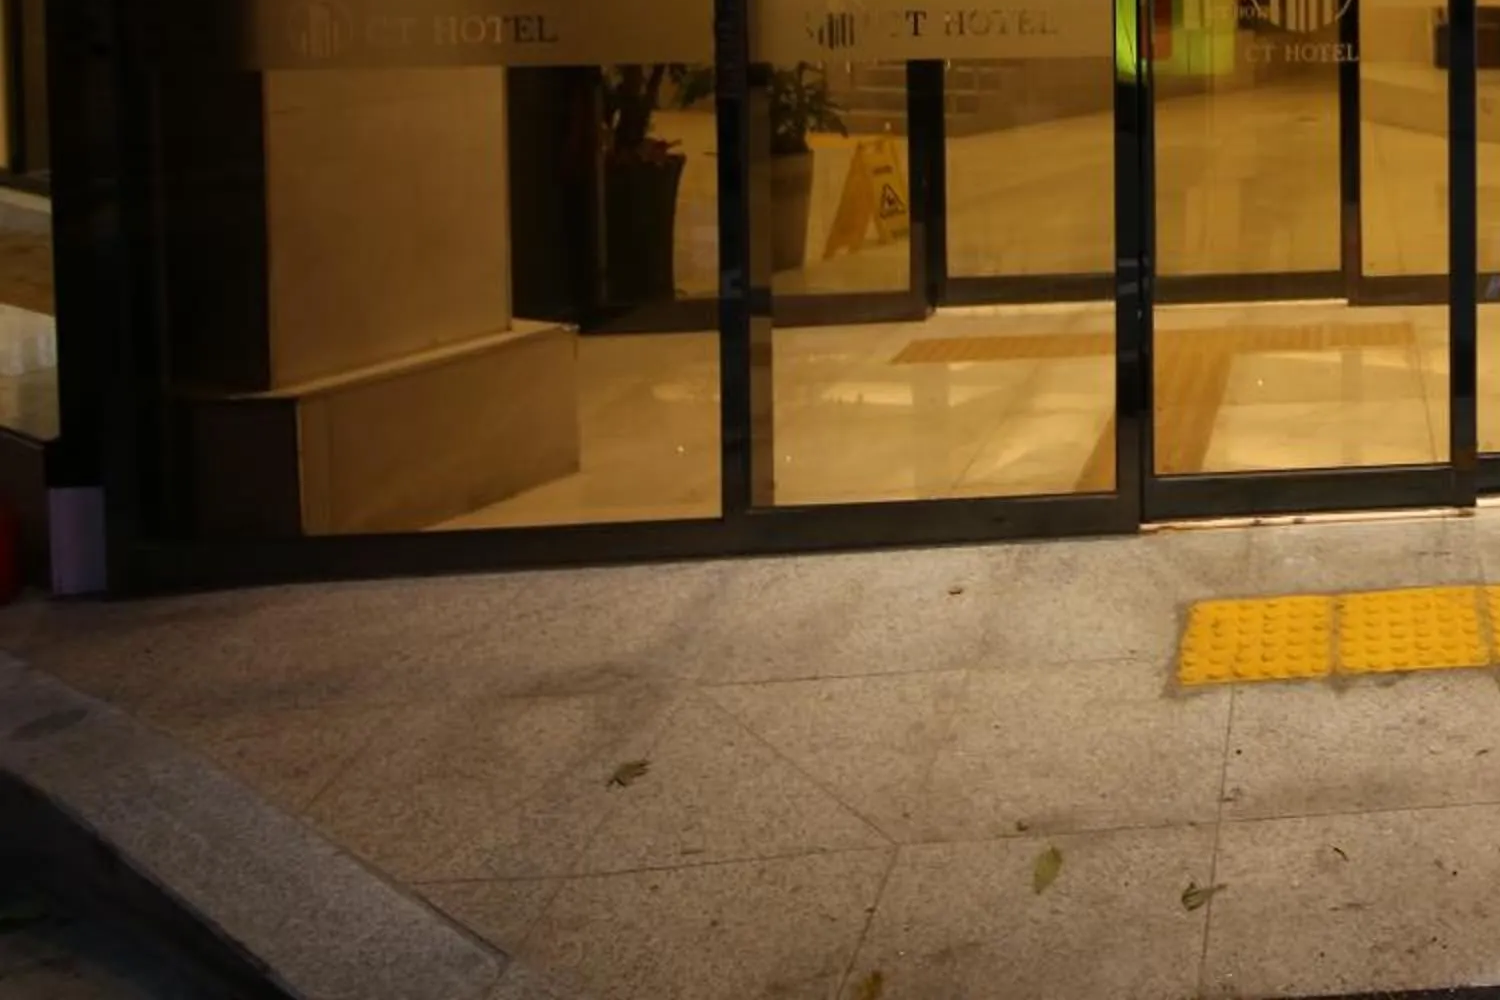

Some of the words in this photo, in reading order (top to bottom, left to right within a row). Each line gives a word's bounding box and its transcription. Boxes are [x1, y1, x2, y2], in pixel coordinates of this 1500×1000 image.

[364, 15, 420, 46] CT
[432, 13, 559, 46] HOTEL
[943, 8, 1059, 38] HOTEL
[1244, 44, 1277, 63] CT
[1285, 43, 1360, 63] HOTEL
